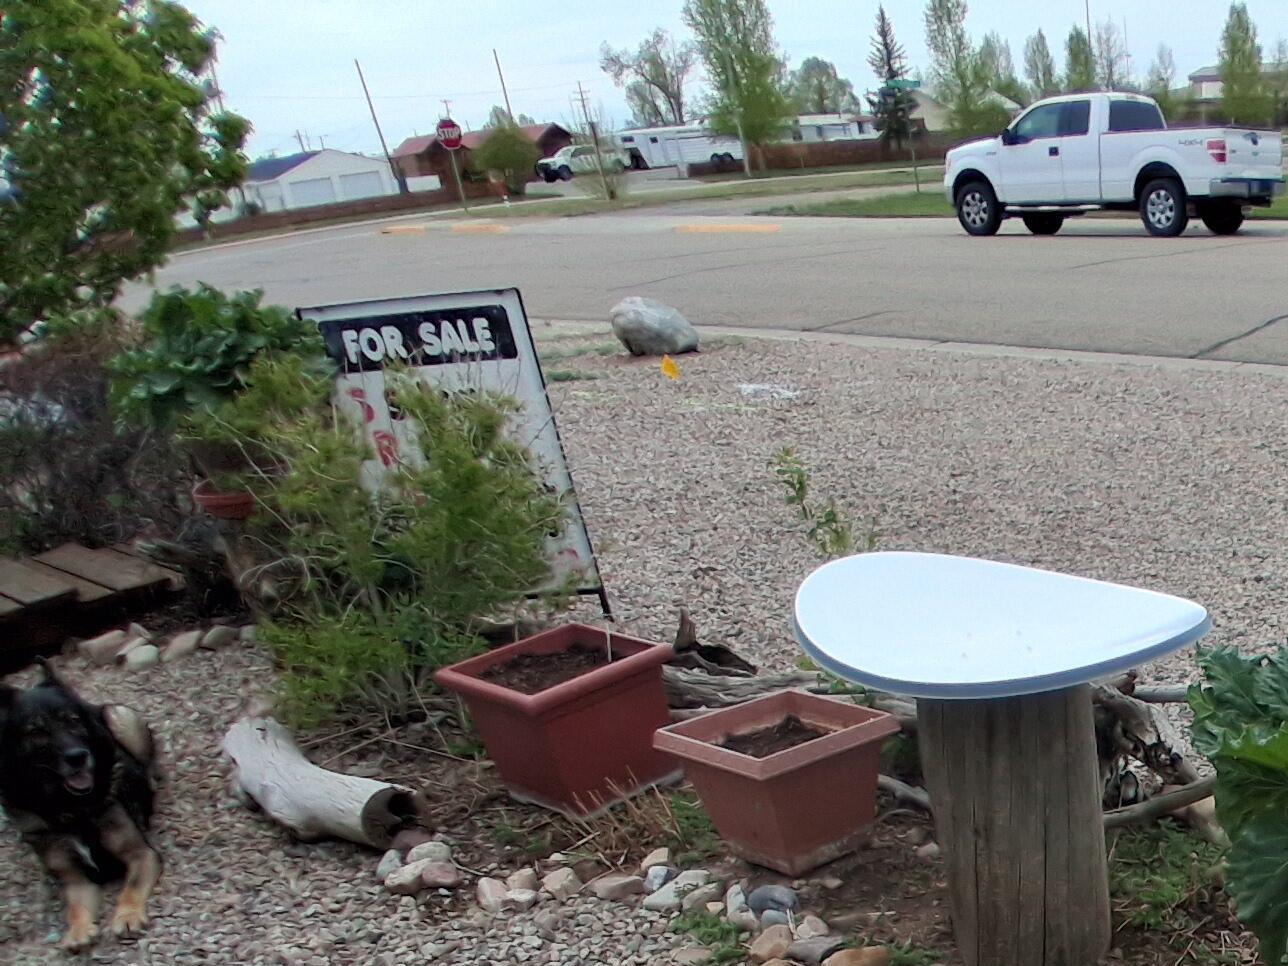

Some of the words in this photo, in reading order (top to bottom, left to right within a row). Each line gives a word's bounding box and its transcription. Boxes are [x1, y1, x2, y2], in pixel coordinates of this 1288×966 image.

[438, 127, 460, 140] STOP
[342, 326, 408, 364] FOR
[418, 317, 496, 357] SALE
